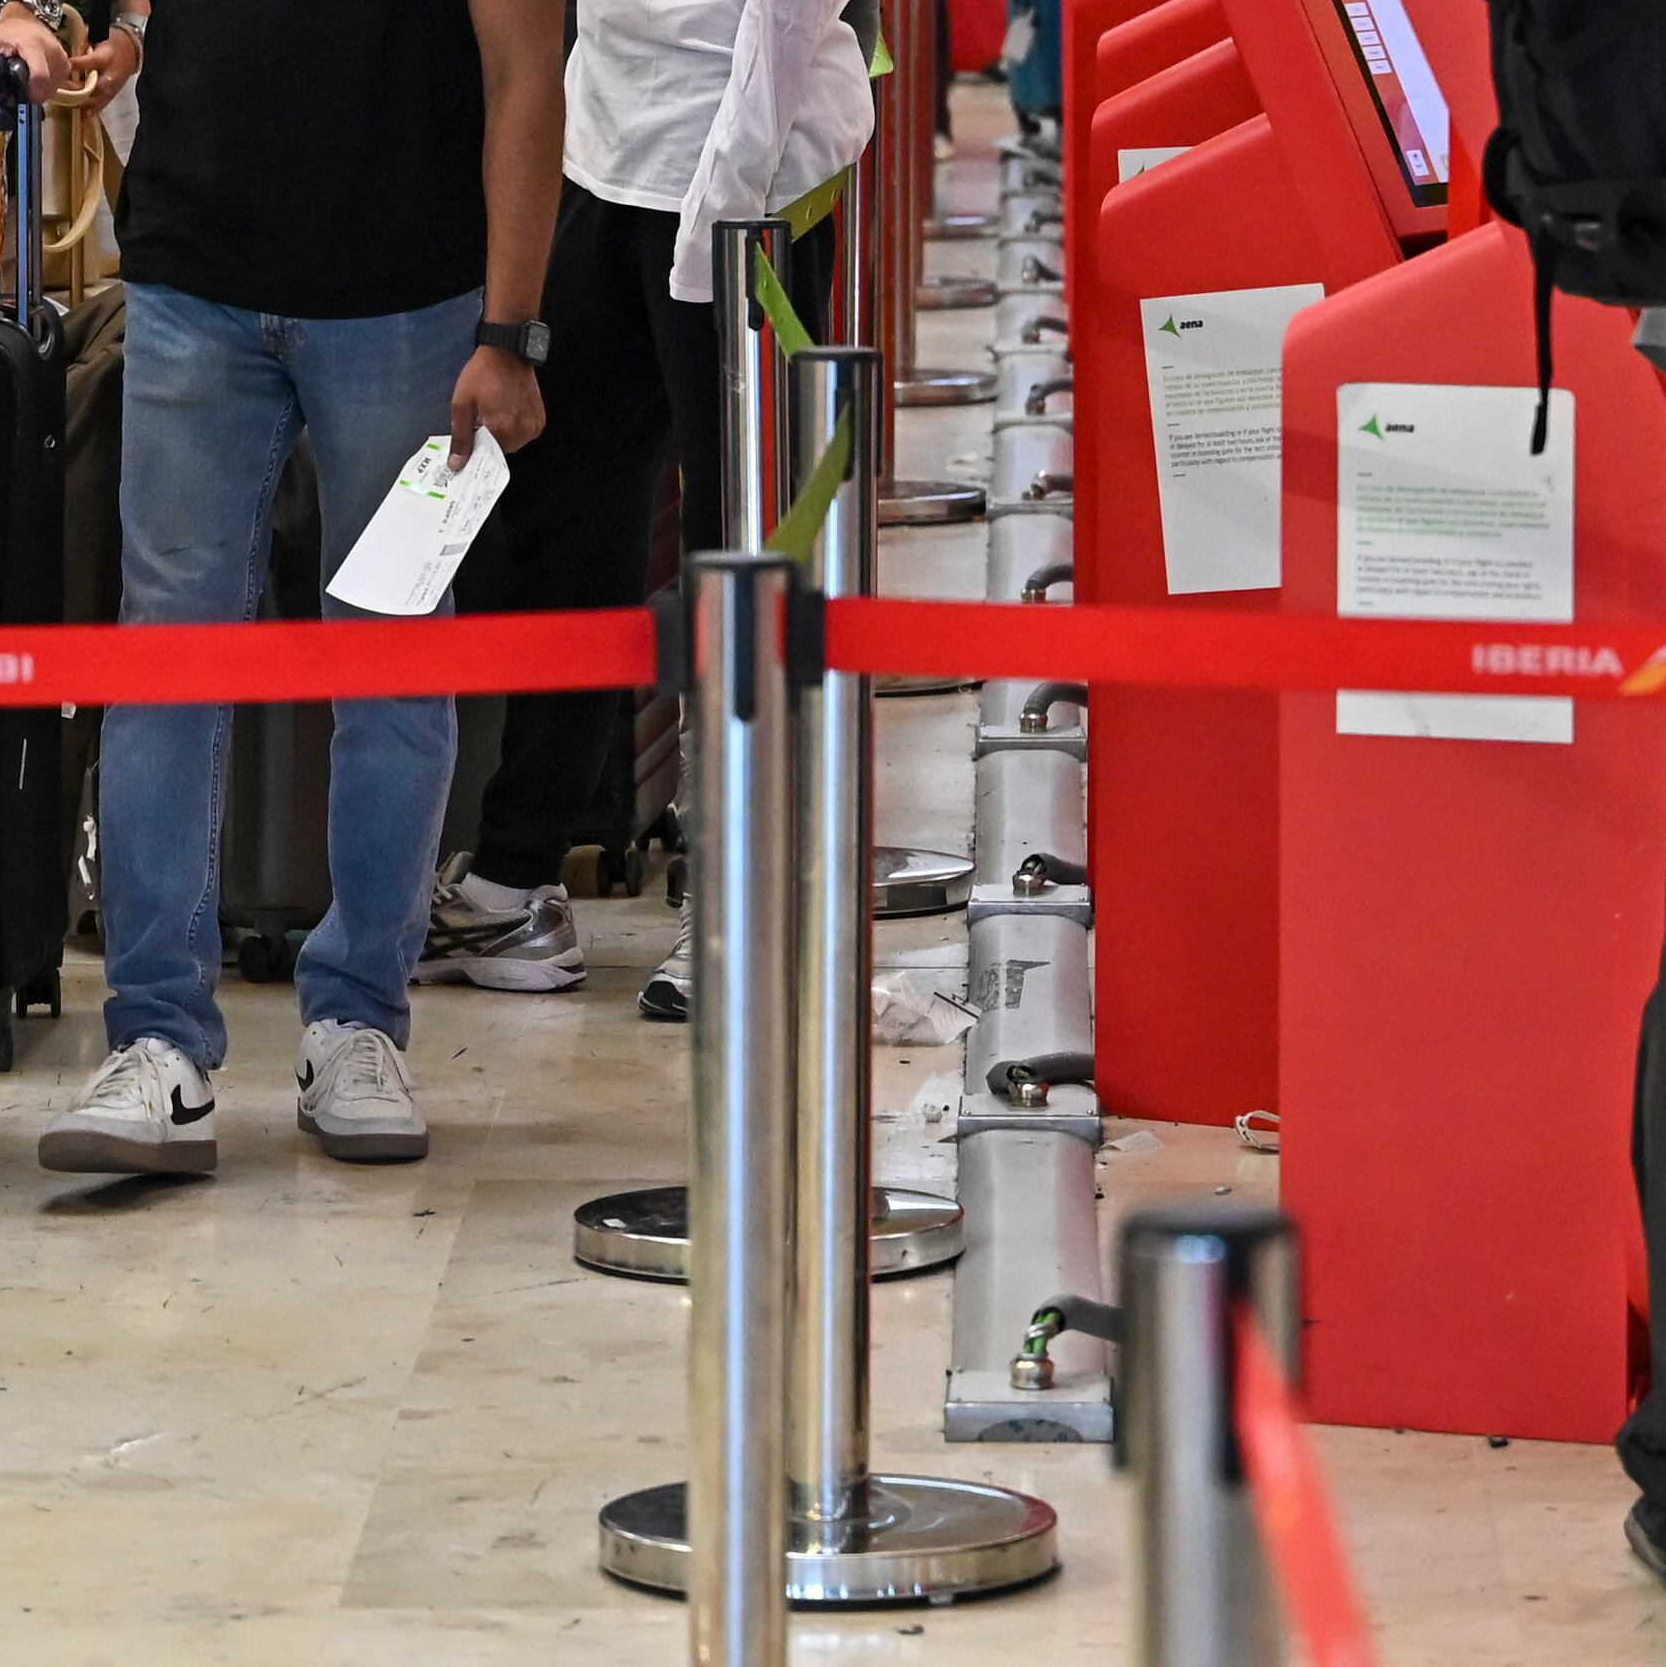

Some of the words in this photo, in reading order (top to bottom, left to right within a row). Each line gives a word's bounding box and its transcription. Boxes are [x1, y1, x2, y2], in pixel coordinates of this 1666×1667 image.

[1179, 319, 1203, 330] aena
[1384, 422, 1415, 433] aena
[1471, 643, 1624, 677] IBERIA
